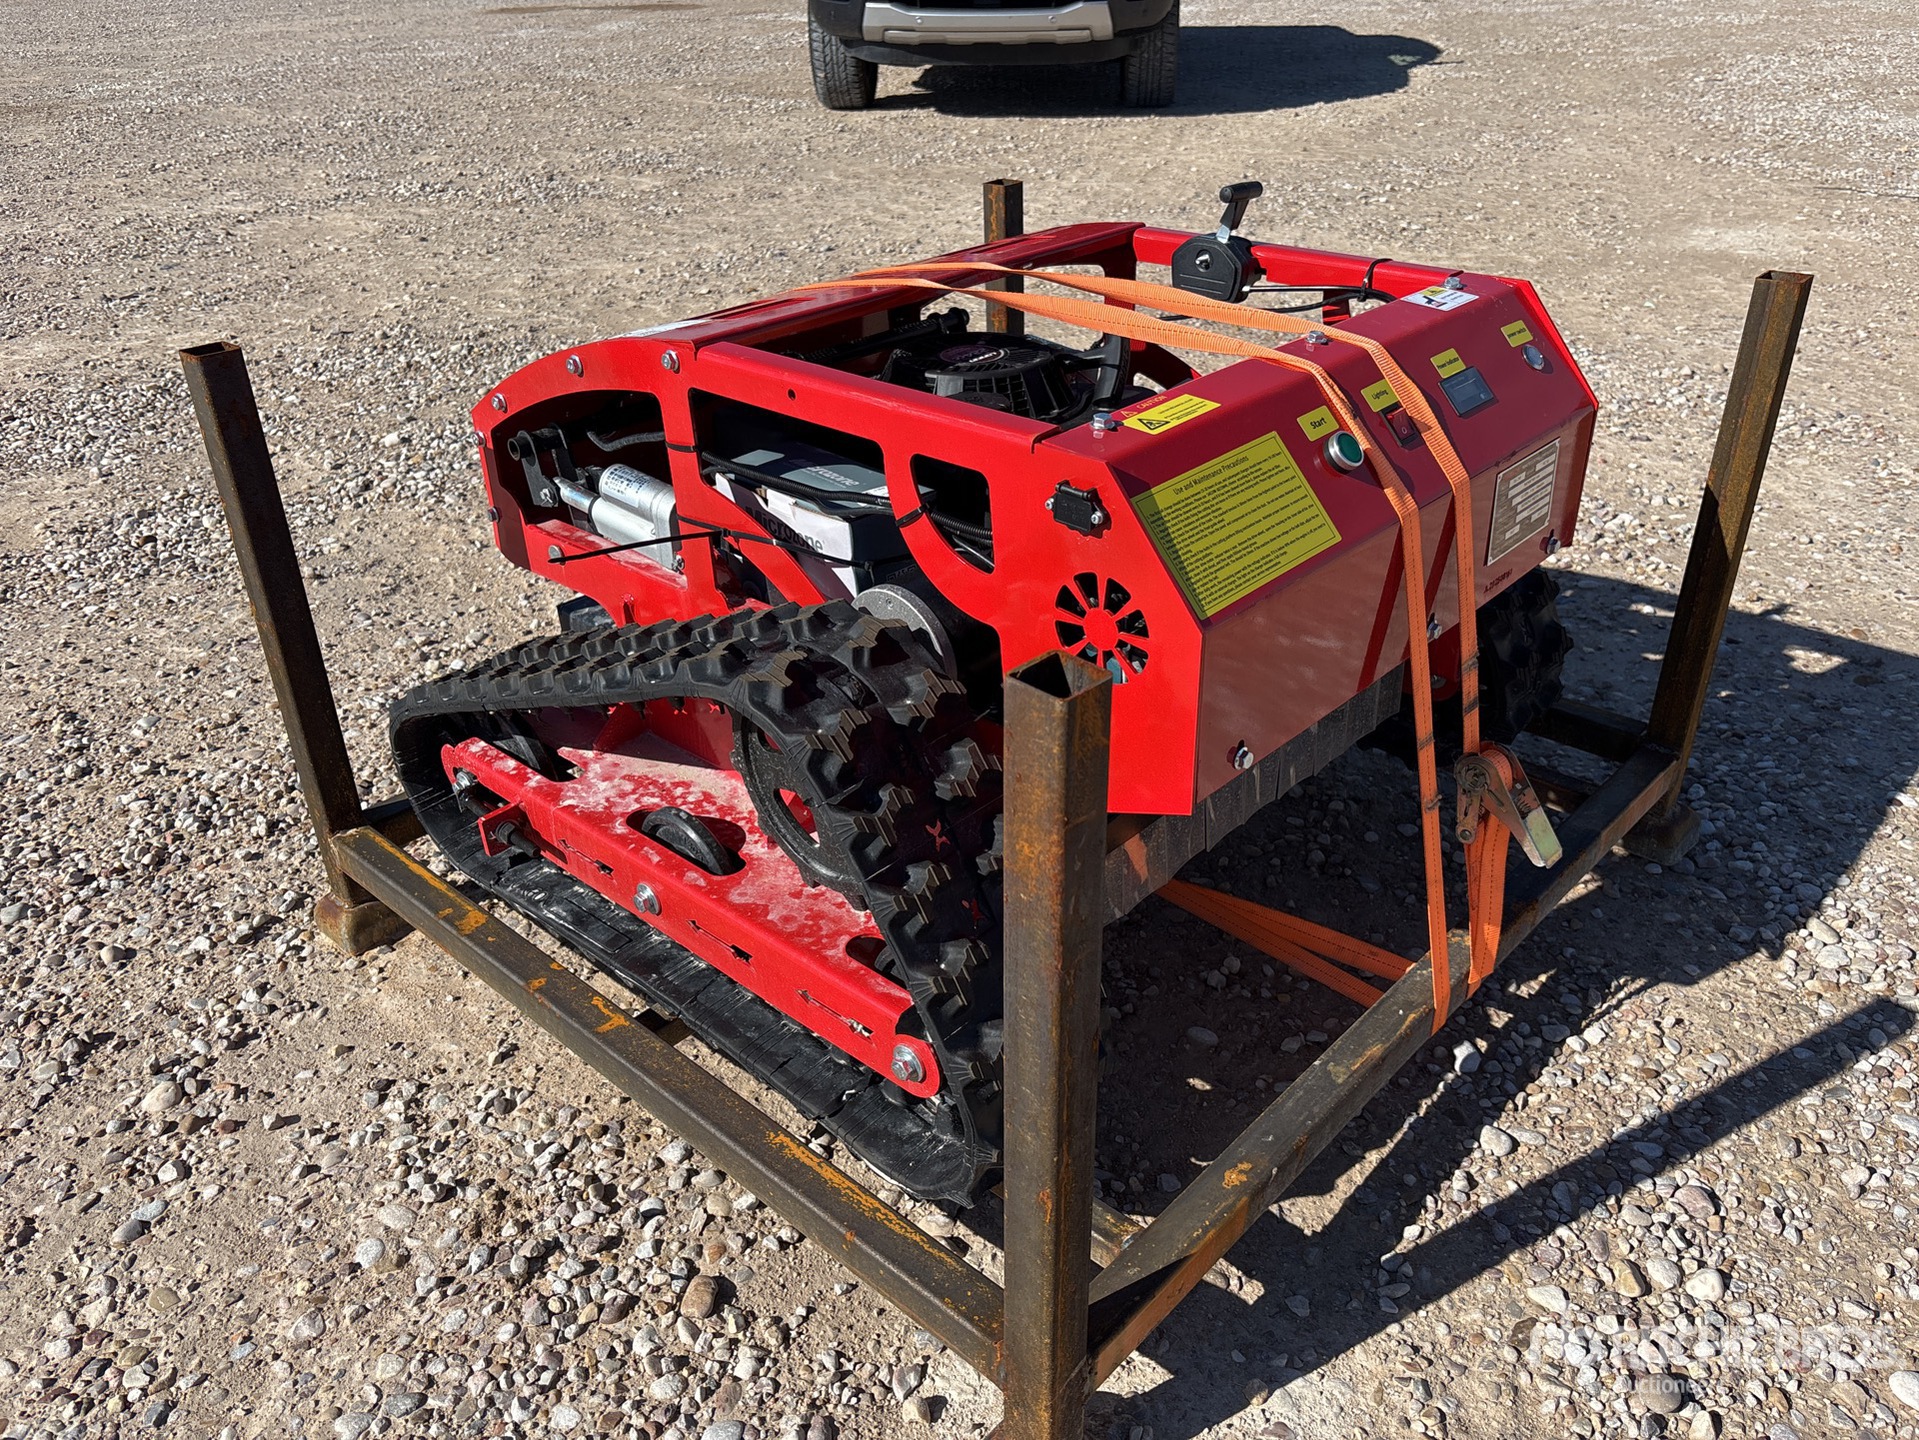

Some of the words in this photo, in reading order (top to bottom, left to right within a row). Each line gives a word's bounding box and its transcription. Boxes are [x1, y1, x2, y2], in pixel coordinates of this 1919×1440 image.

[1136, 395, 1168, 409] CAUTION
[1371, 388, 1389, 401] Lighting
[1310, 415, 1327, 430] Start
[804, 465, 860, 486] crozone
[1172, 487, 1184, 496] Use
[1184, 481, 1195, 491] and
[1192, 468, 1223, 486] Maintenance
[1221, 455, 1249, 472] Precautions
[745, 506, 823, 551] Microzone
